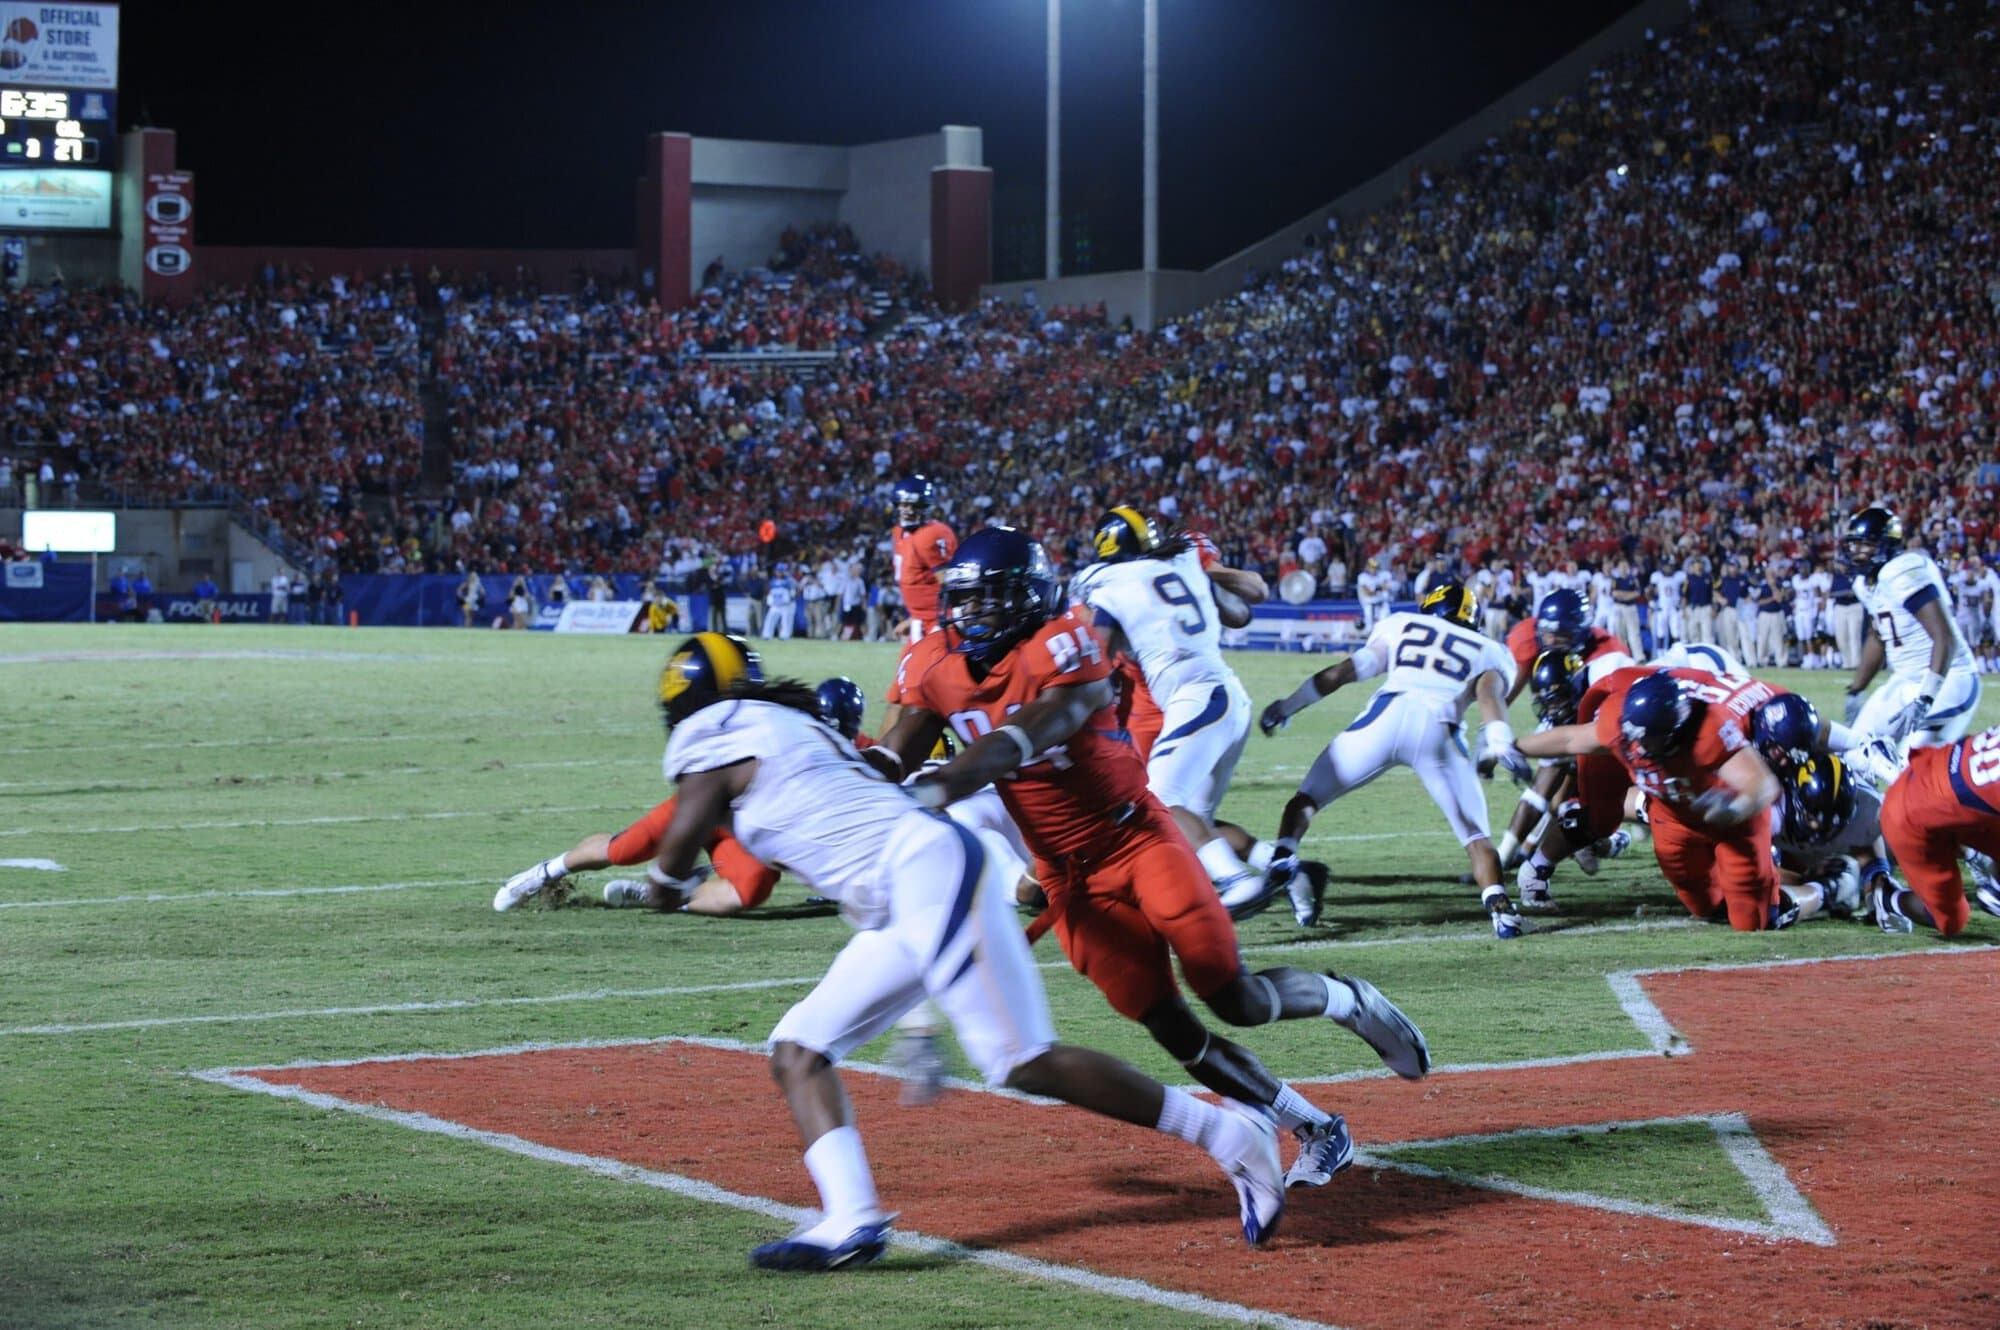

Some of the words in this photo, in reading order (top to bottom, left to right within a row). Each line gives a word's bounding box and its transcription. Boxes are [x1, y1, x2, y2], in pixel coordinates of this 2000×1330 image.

[40, 8, 102, 26] OFFICIAL
[47, 29, 91, 46] STORE
[1152, 571, 1206, 636] 9
[1045, 625, 1102, 674] 84
[1395, 621, 1483, 682] 25
